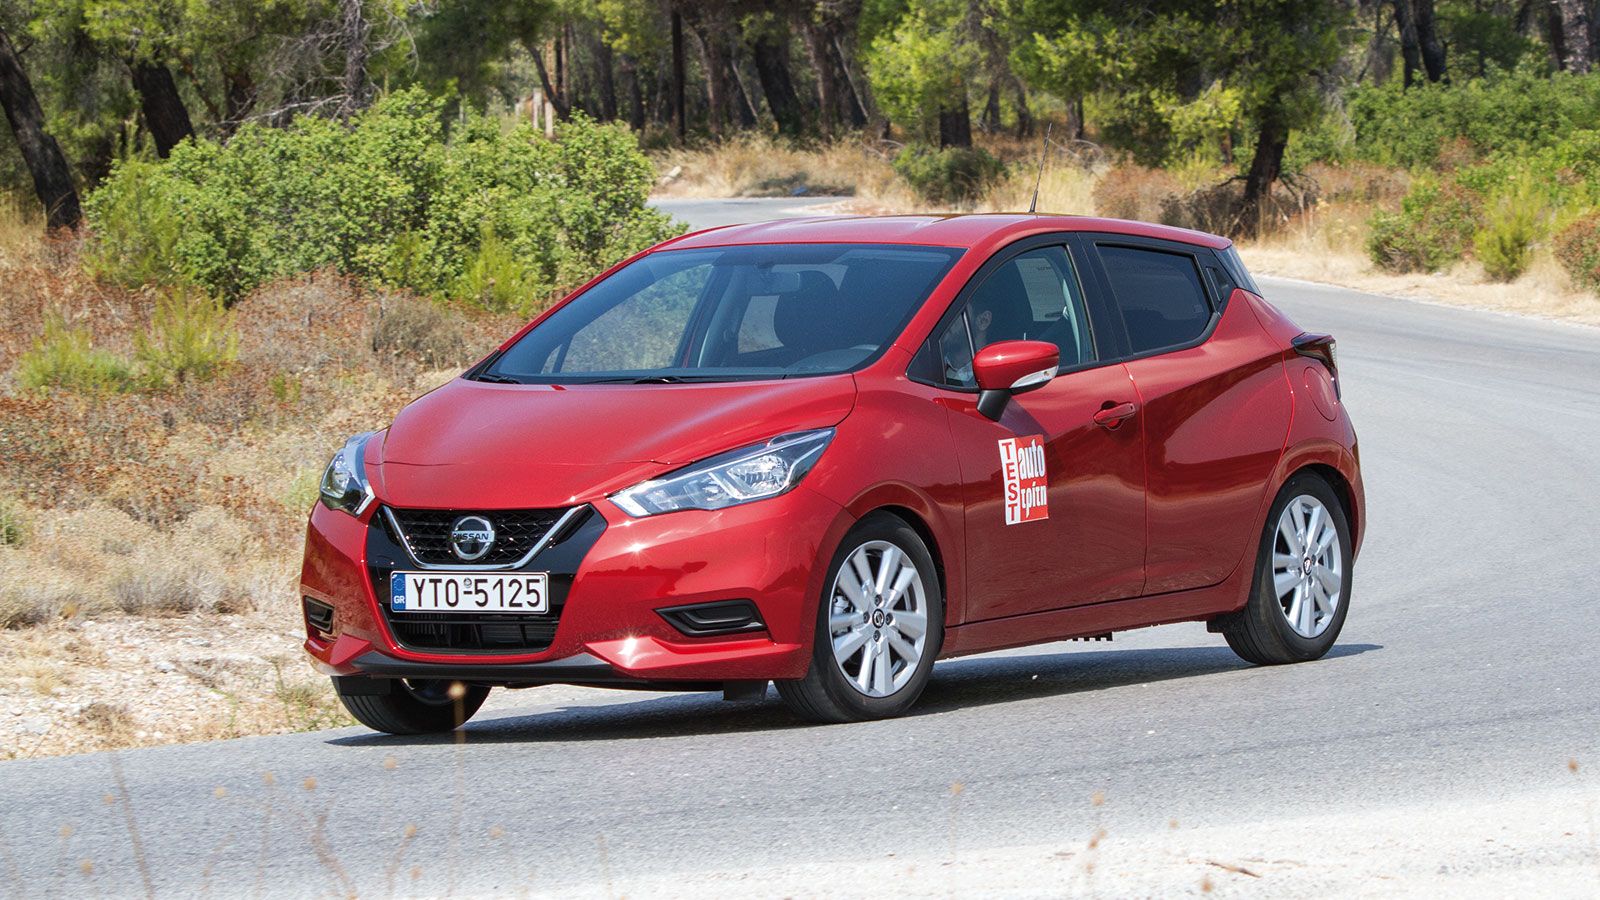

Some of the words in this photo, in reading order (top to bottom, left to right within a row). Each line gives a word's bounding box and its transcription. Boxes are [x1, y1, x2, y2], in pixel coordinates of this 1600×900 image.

[1018, 439, 1045, 480] auto
[1002, 442, 1018, 521] TEST
[452, 532, 489, 540] NISSAN
[393, 596, 405, 604] GR
